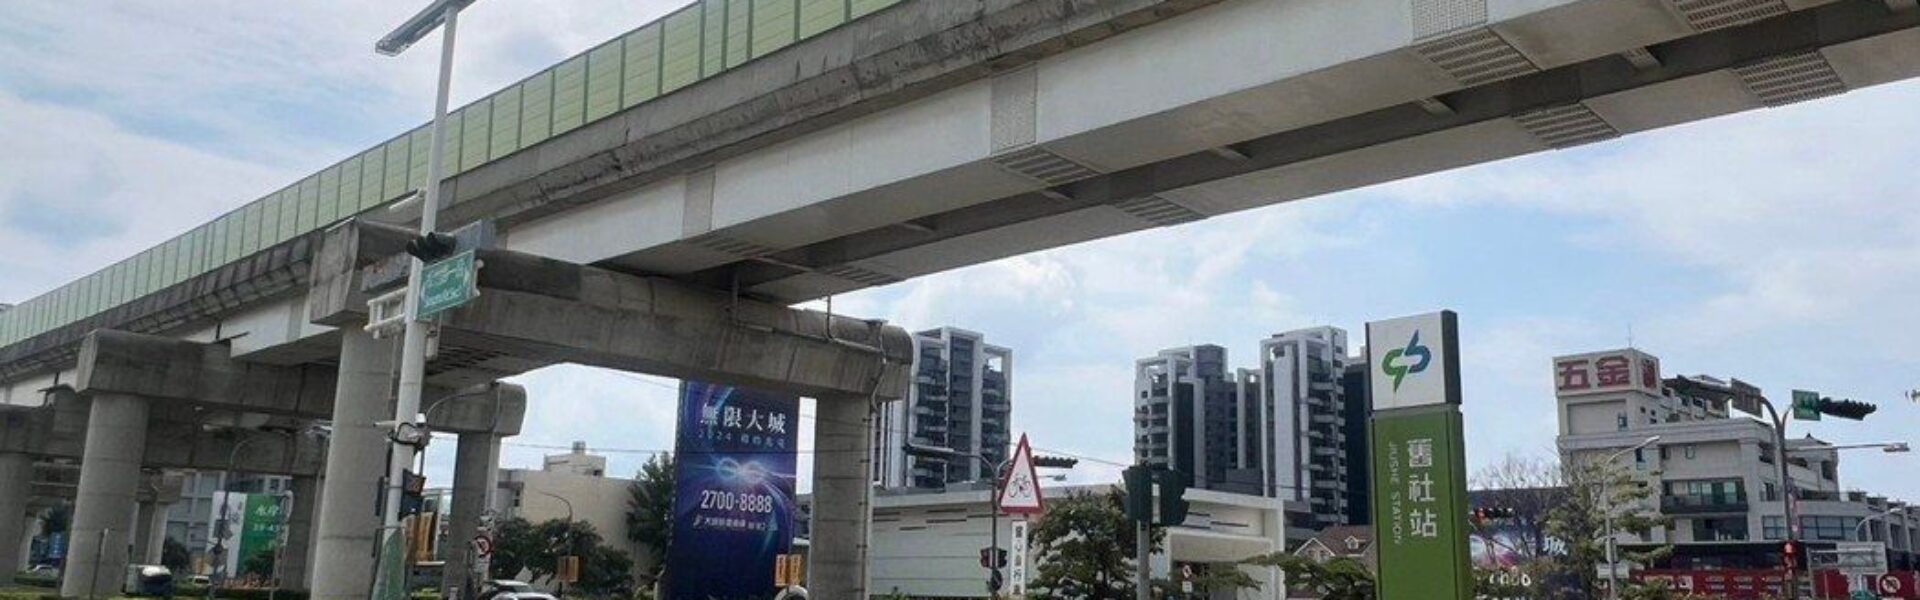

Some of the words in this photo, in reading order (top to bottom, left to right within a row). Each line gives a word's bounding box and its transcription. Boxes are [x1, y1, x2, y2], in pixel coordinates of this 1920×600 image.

[1557, 355, 1631, 390] 五金
[701, 402, 786, 434] 無限大城
[1388, 441, 1400, 485] JIUSHE
[700, 489, 773, 513] 2700-8888
[1406, 438, 1437, 537] 舊社站
[1390, 491, 1402, 545] STATION
